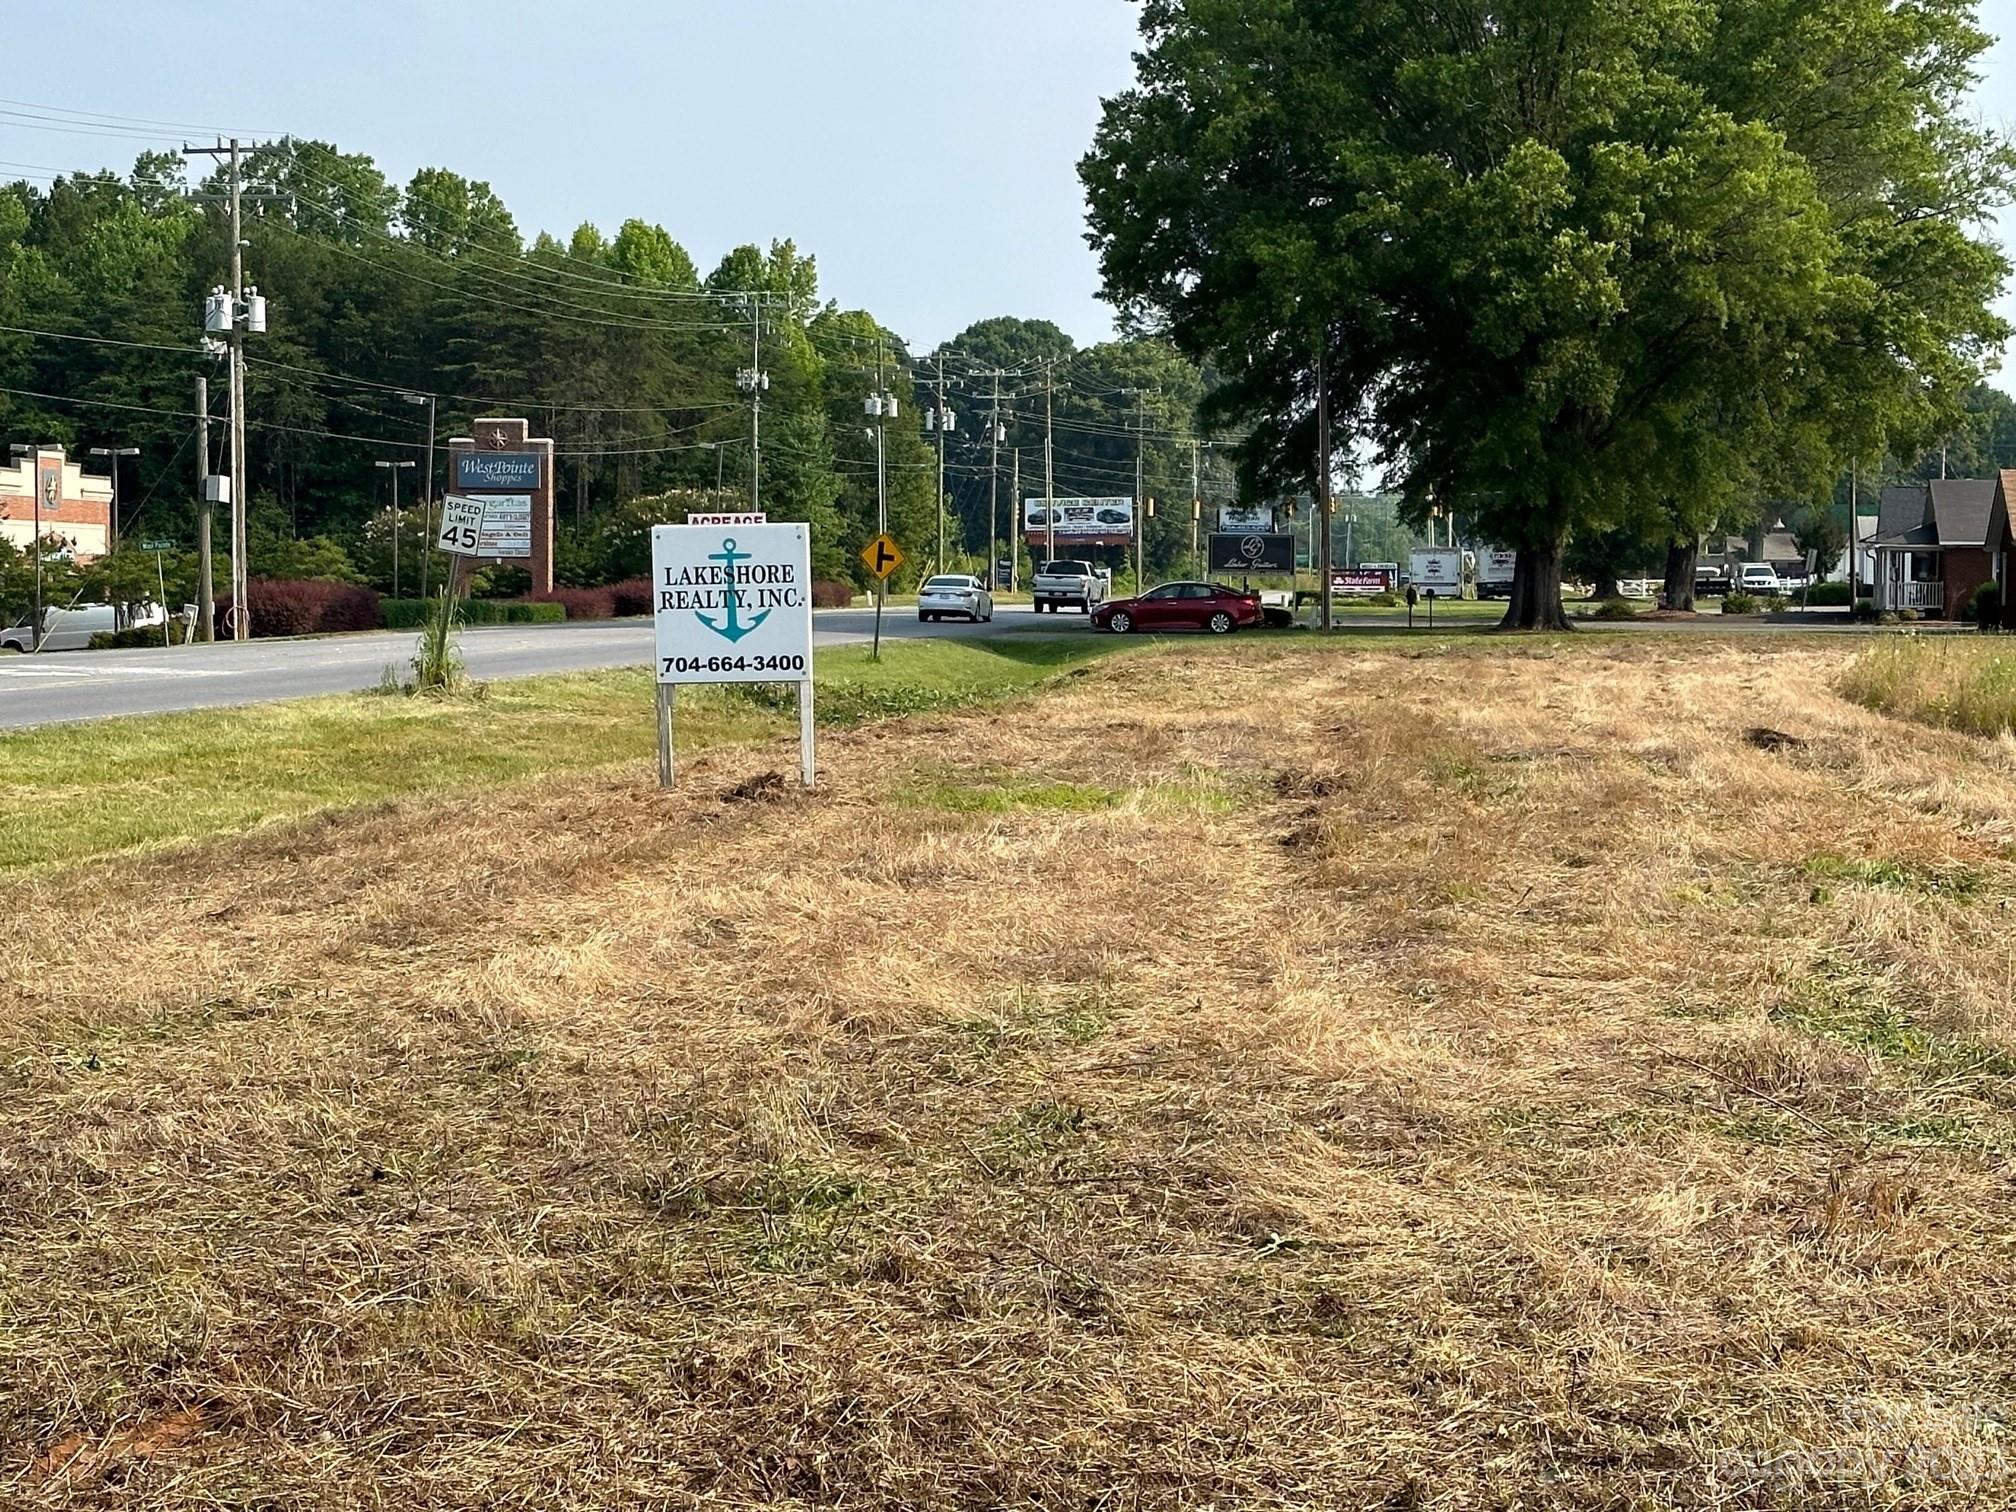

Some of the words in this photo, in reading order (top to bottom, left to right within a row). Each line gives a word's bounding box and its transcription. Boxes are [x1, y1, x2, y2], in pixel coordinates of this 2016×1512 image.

[484, 472, 522, 485] Shoppes
[447, 502, 481, 516] SPEED
[449, 513, 476, 526] LIMIT
[441, 526, 477, 549] 45
[664, 564, 795, 586] LAKESHORE
[660, 588, 753, 611] REALTY,
[757, 587, 803, 608] INC.
[662, 654, 805, 673] 704-664-3400
